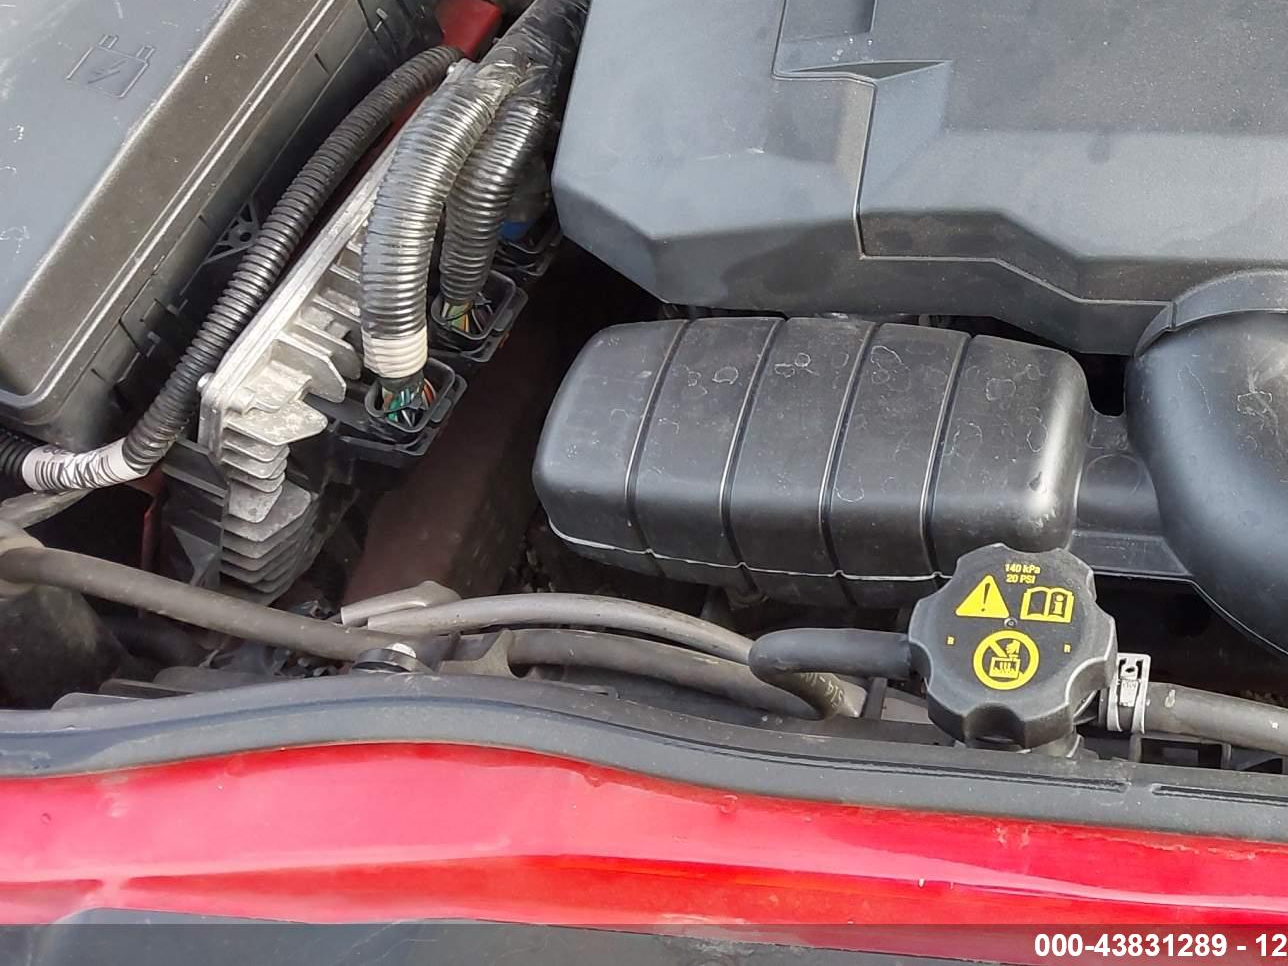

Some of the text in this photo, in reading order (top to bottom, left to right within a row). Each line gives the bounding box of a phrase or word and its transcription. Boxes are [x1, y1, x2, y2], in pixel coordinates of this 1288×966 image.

[1005, 563, 1041, 574] 140 kPa
[1006, 573, 1036, 584] 20 PSI
